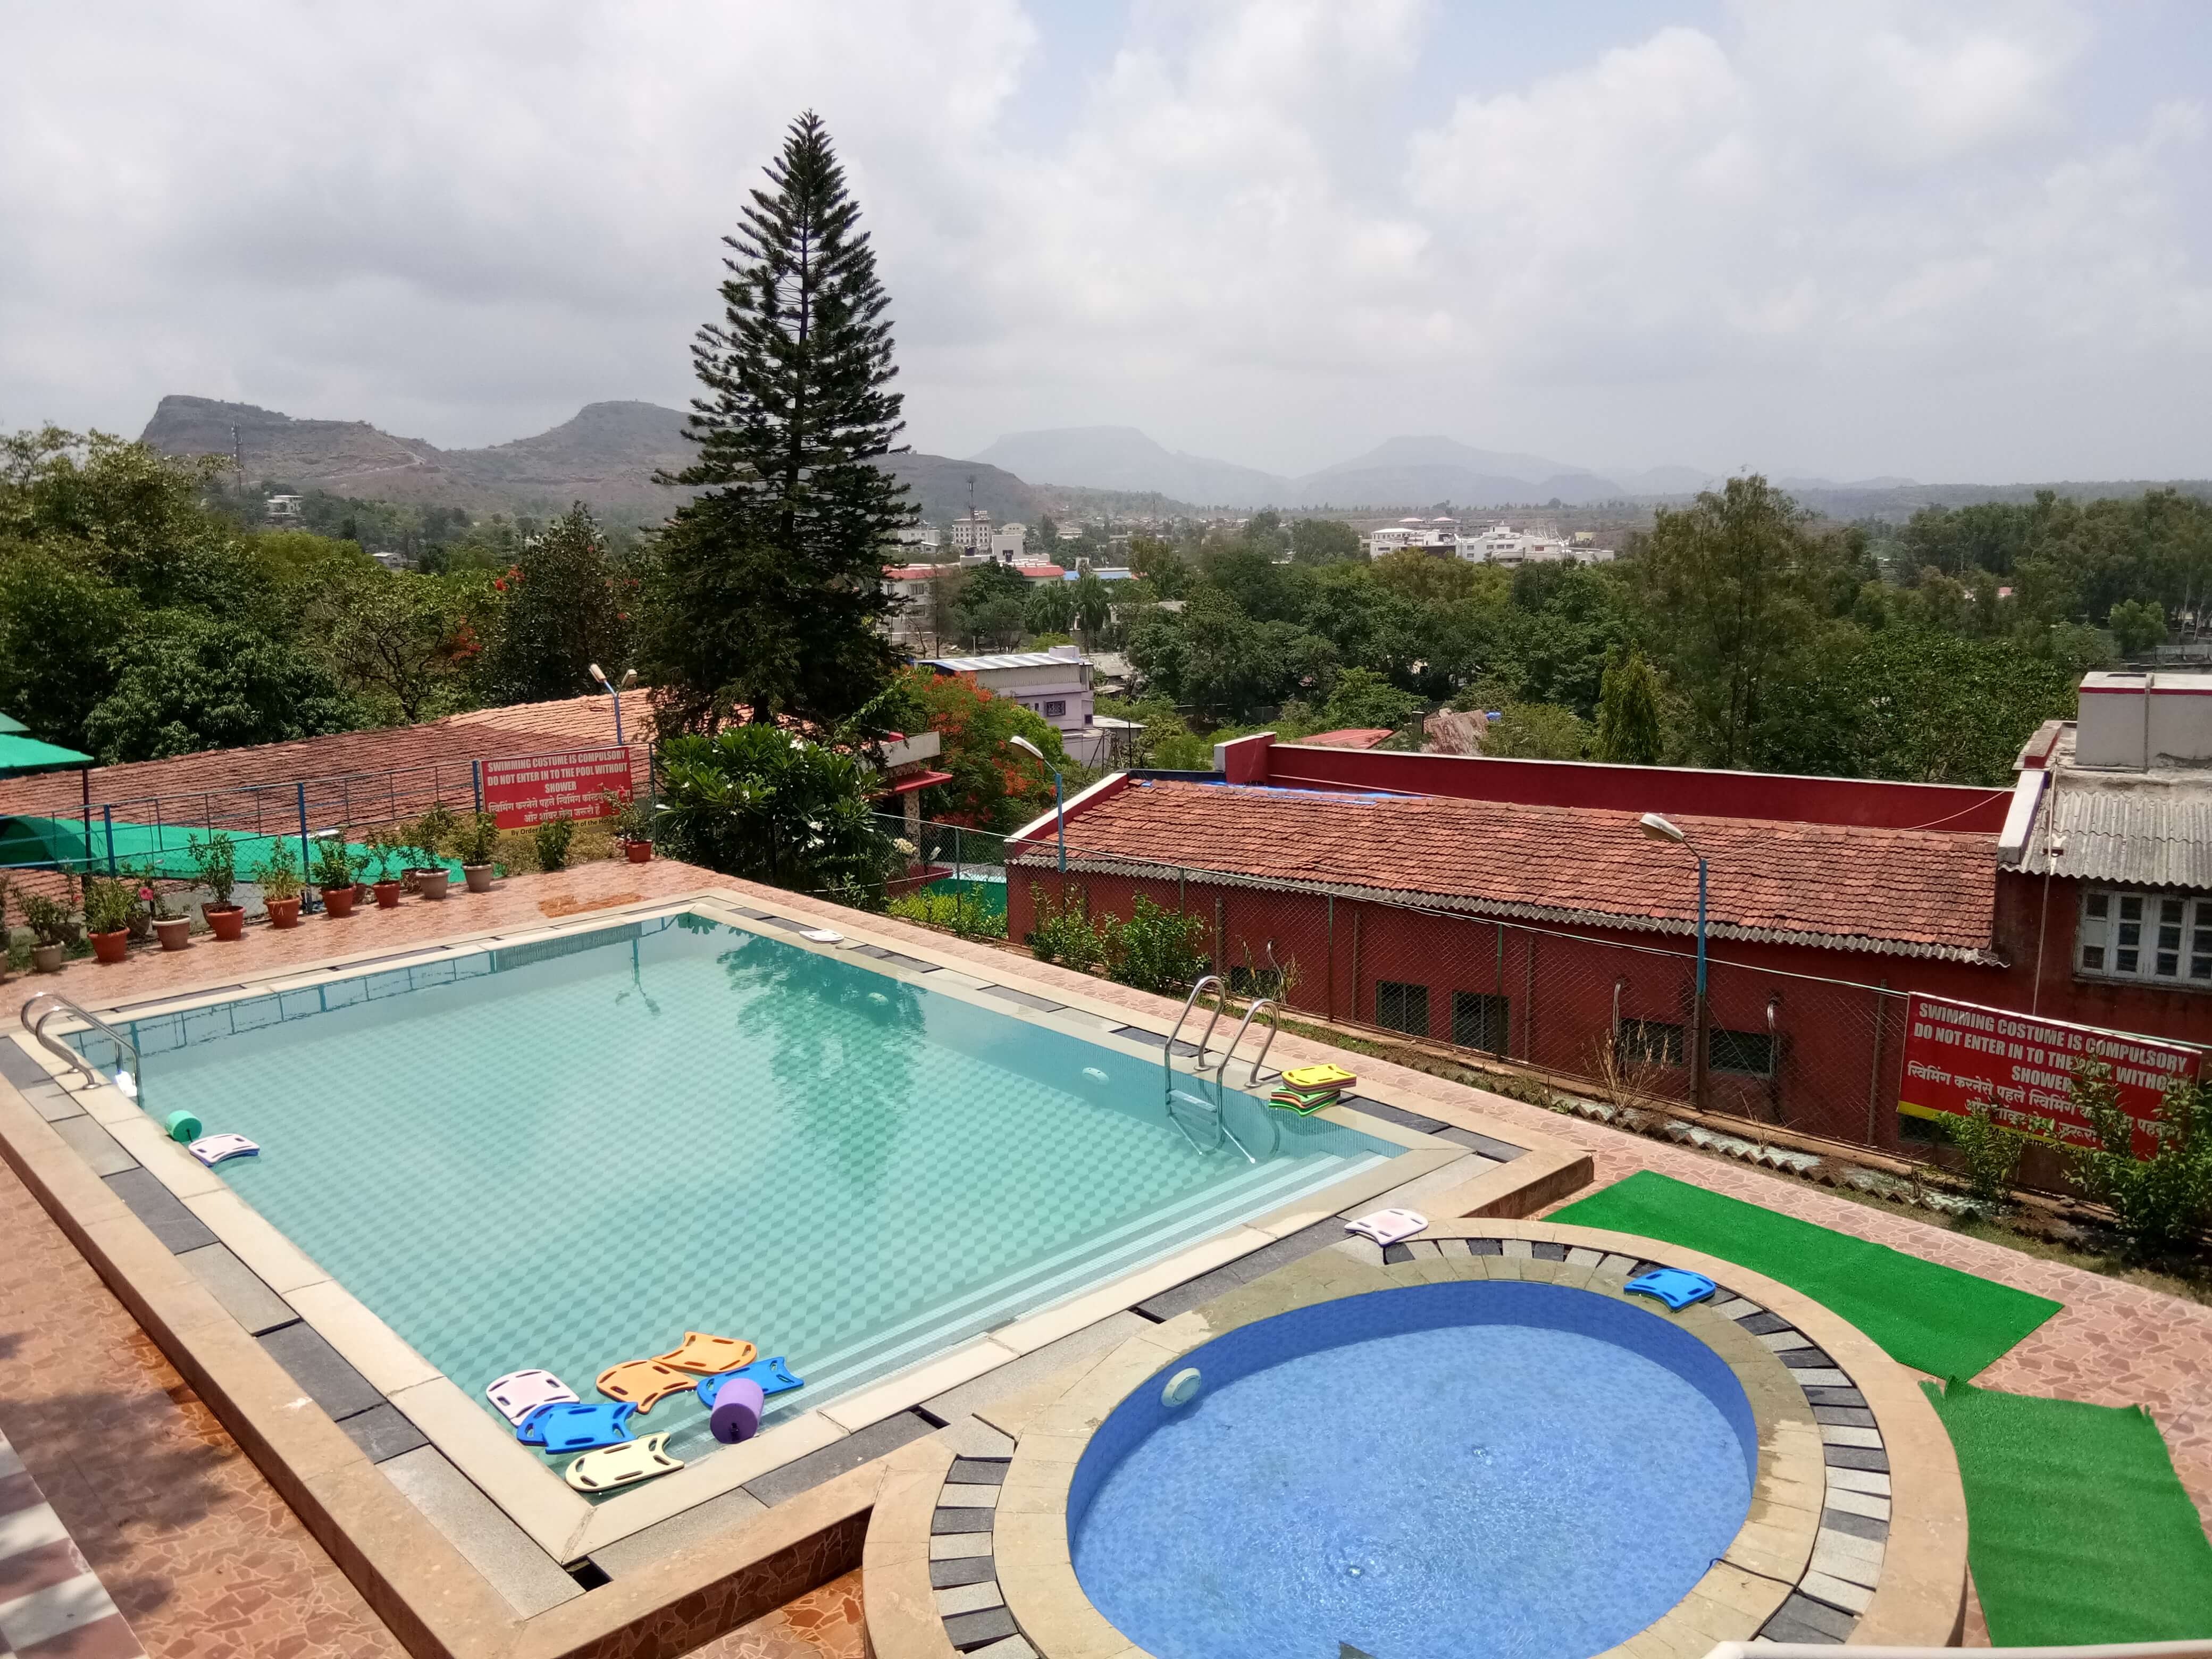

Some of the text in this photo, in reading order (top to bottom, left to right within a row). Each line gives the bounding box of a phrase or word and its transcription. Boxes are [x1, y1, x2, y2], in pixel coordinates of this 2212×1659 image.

[488, 750, 626, 773] SWIMMING COSTUME IS COMPULSORY
[488, 763, 627, 786] DO NOT ENTER IN TO THE POOL WITHOUT
[544, 781, 577, 793] SHOWER
[524, 811, 538, 822] और
[594, 803, 600, 816] है
[539, 795, 555, 808] पहले
[1914, 1023, 1932, 1039] DO
[1935, 1027, 1963, 1046] NOT
[1964, 1033, 2006, 1056] ENTER
[2008, 1043, 2024, 1060] IN
[2026, 1046, 2045, 1065] TO
[2048, 1052, 2073, 1071] THE
[1919, 1003, 2188, 1073] SWIMMING COSTUME IS COMPULSORY
[1907, 1060, 1952, 1085] स्विमिंग
[1954, 1075, 1995, 1096] करनेसे
[1997, 1085, 2026, 1104] पहले
[2029, 1088, 2077, 1116] स्विमिंग
[2012, 1066, 2072, 1093] SHOWER
